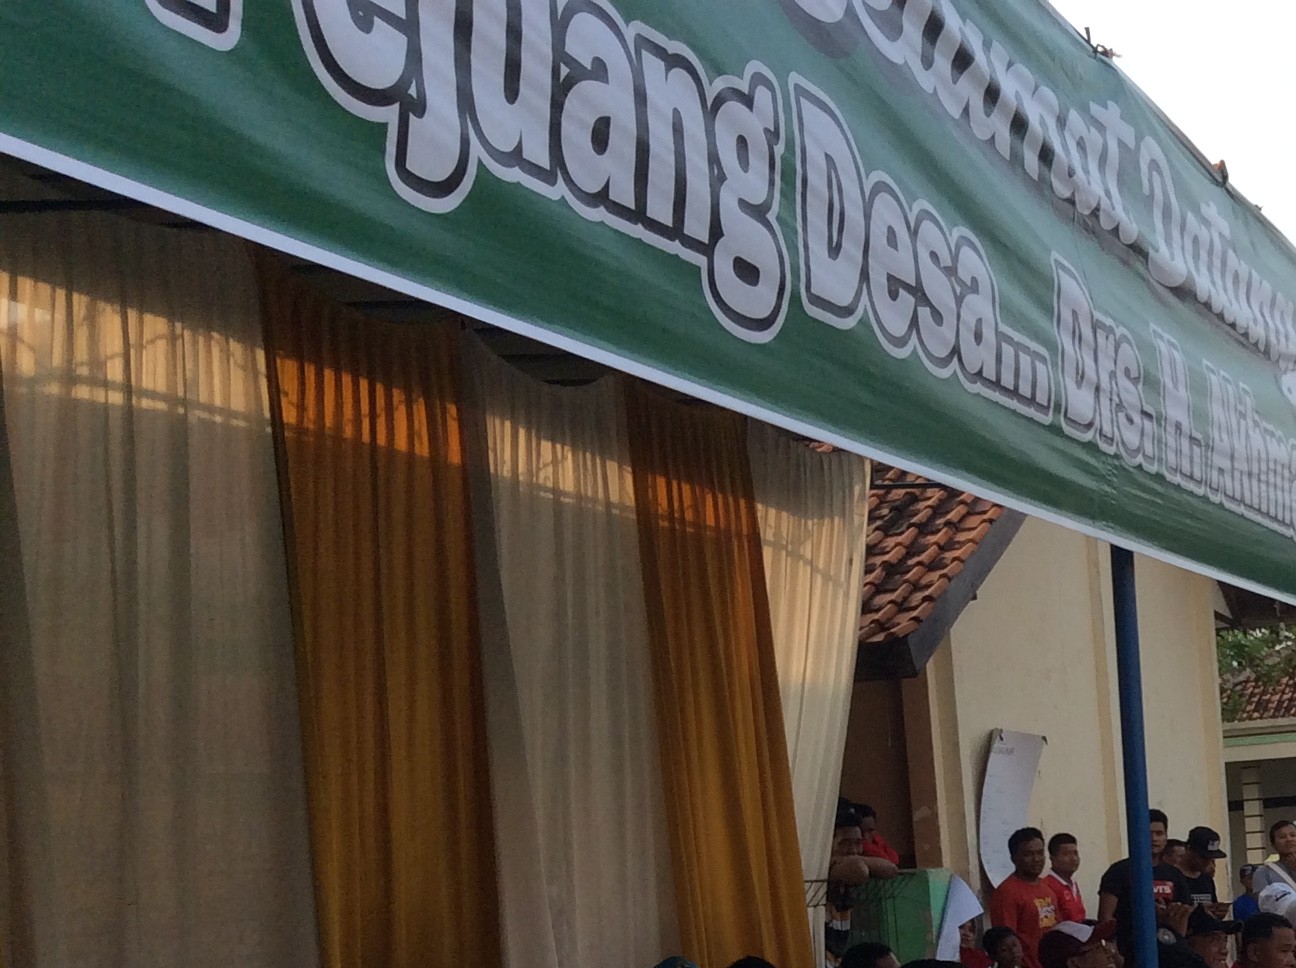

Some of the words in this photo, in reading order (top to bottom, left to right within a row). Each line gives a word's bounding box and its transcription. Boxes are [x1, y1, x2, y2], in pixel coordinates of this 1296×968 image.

[145, 0, 790, 343] ejuang
[1051, 250, 1157, 474] Drs.
[1150, 322, 1205, 496] H.
